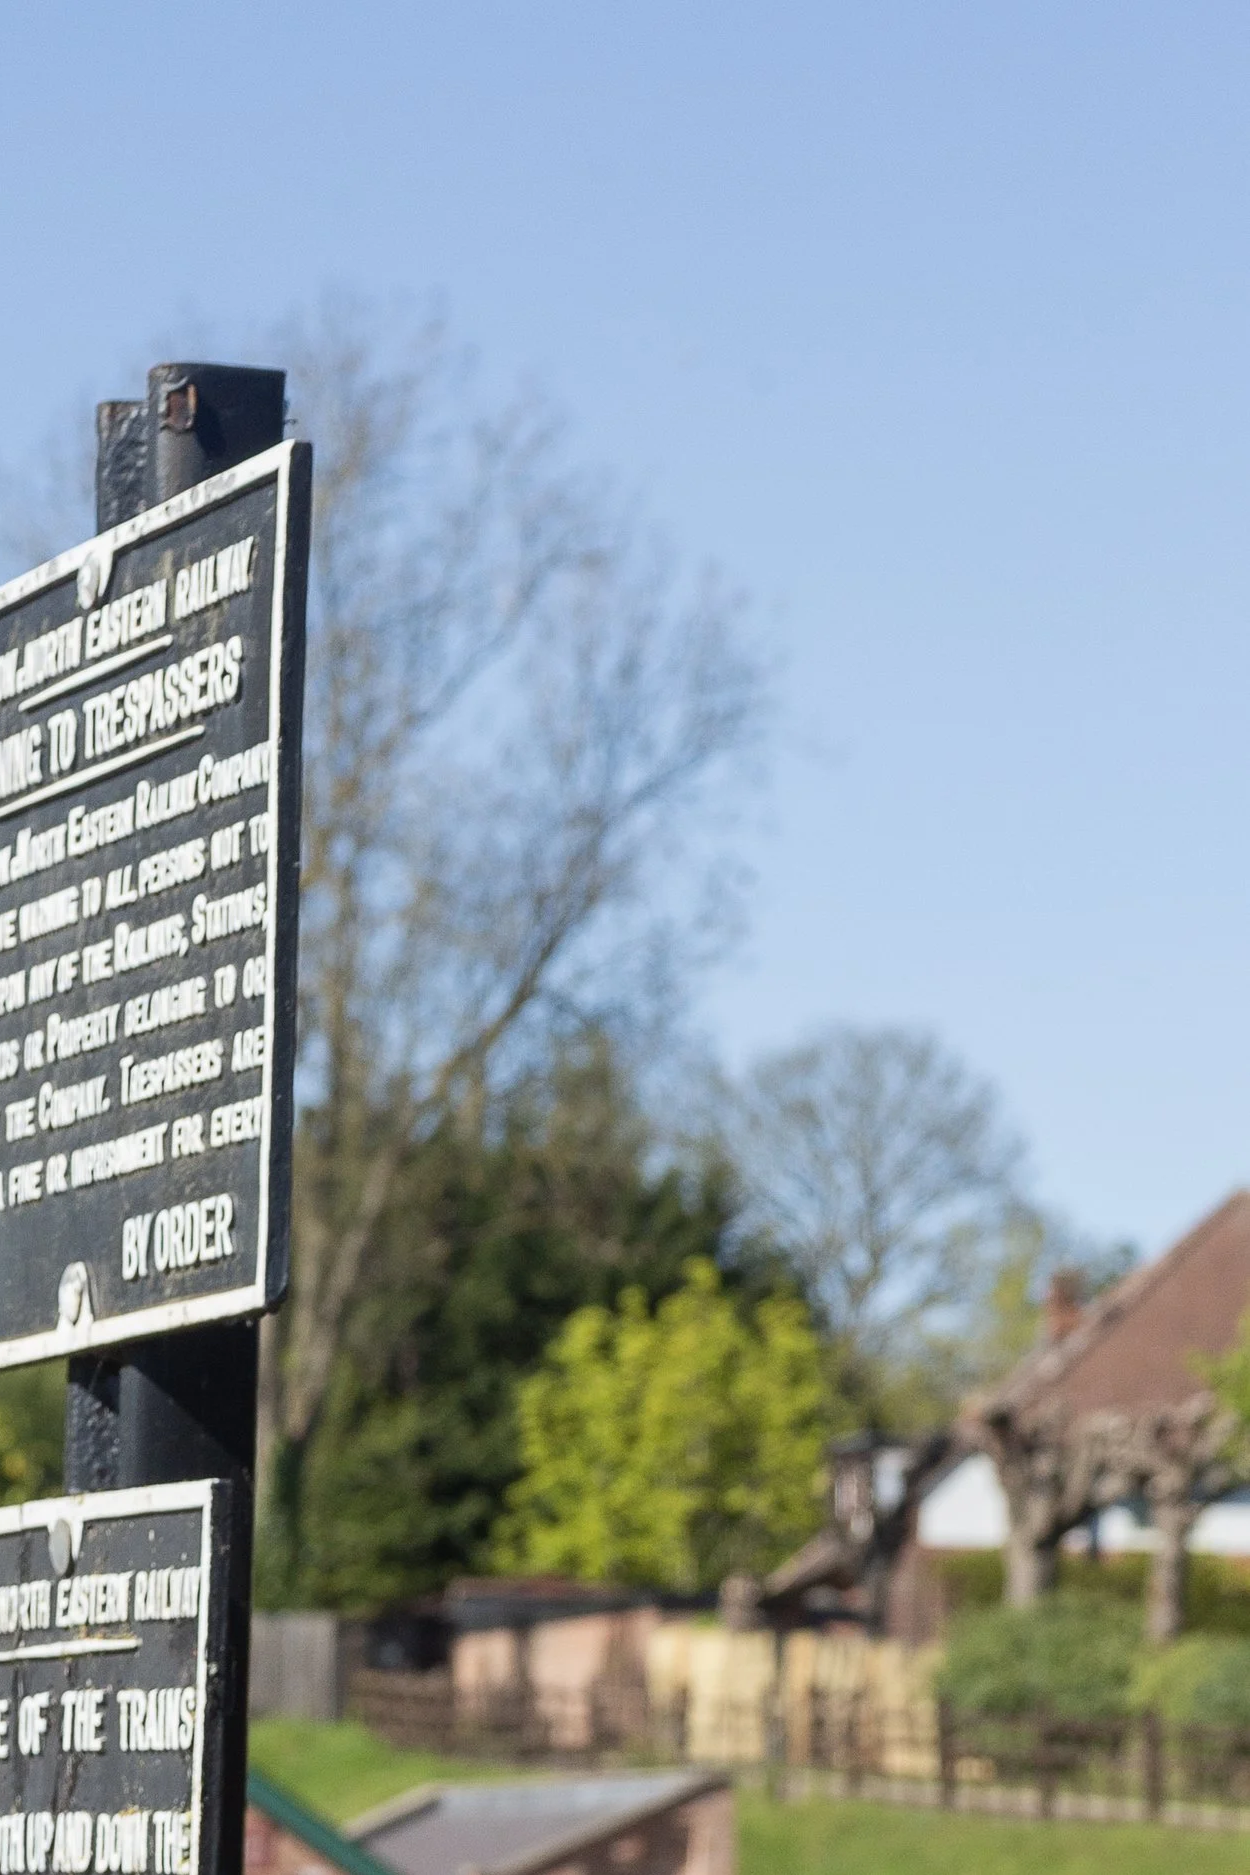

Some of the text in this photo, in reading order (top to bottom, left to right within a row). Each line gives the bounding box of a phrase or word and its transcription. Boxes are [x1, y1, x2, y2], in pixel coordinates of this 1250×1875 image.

[86, 578, 167, 660] EASTERN
[175, 536, 255, 620] RAILWAY
[48, 709, 76, 775] TO
[83, 636, 243, 759] TRESPASSERS
[67, 795, 134, 857] EASTERN
[135, 770, 199, 831] RAILWAY
[198, 741, 270, 805] COMPANY
[19, 885, 79, 942] WARNING
[82, 876, 101, 919] TO
[105, 864, 138, 910] ALL
[138, 837, 206, 898] PERSONS
[211, 821, 246, 871] NOT
[249, 811, 269, 856] TO
[24, 1030, 44, 1071] OR
[47, 1003, 120, 1063] PROPERTY
[124, 976, 207, 1037] BELONGING
[214, 964, 237, 1008] TO
[243, 956, 266, 999] OR
[28, 957, 58, 1005] ANY
[57, 950, 80, 993] OF
[82, 938, 113, 985] THE
[6, 1097, 36, 1142] THE
[120, 1038, 223, 1105] TRESPASSERS
[231, 1025, 265, 1074] ARE
[9, 1160, 43, 1207] FINE
[46, 1153, 68, 1194] OR
[71, 1122, 168, 1188] IMPRISONMENT
[172, 1113, 204, 1158] FOR
[210, 1095, 262, 1147] EVERY
[123, 1193, 233, 1281] BY ORDER
[55, 1571, 133, 1627] EASTERN
[134, 1566, 200, 1621] RAILWAY
[18, 1691, 49, 1755] OF
[61, 1689, 106, 1751] THE
[117, 1687, 196, 1751] TRAINS
[27, 1811, 54, 1873] UP
[53, 1810, 93, 1873] AND
[95, 1810, 150, 1874] DOWN
[153, 1810, 191, 1875] THE
